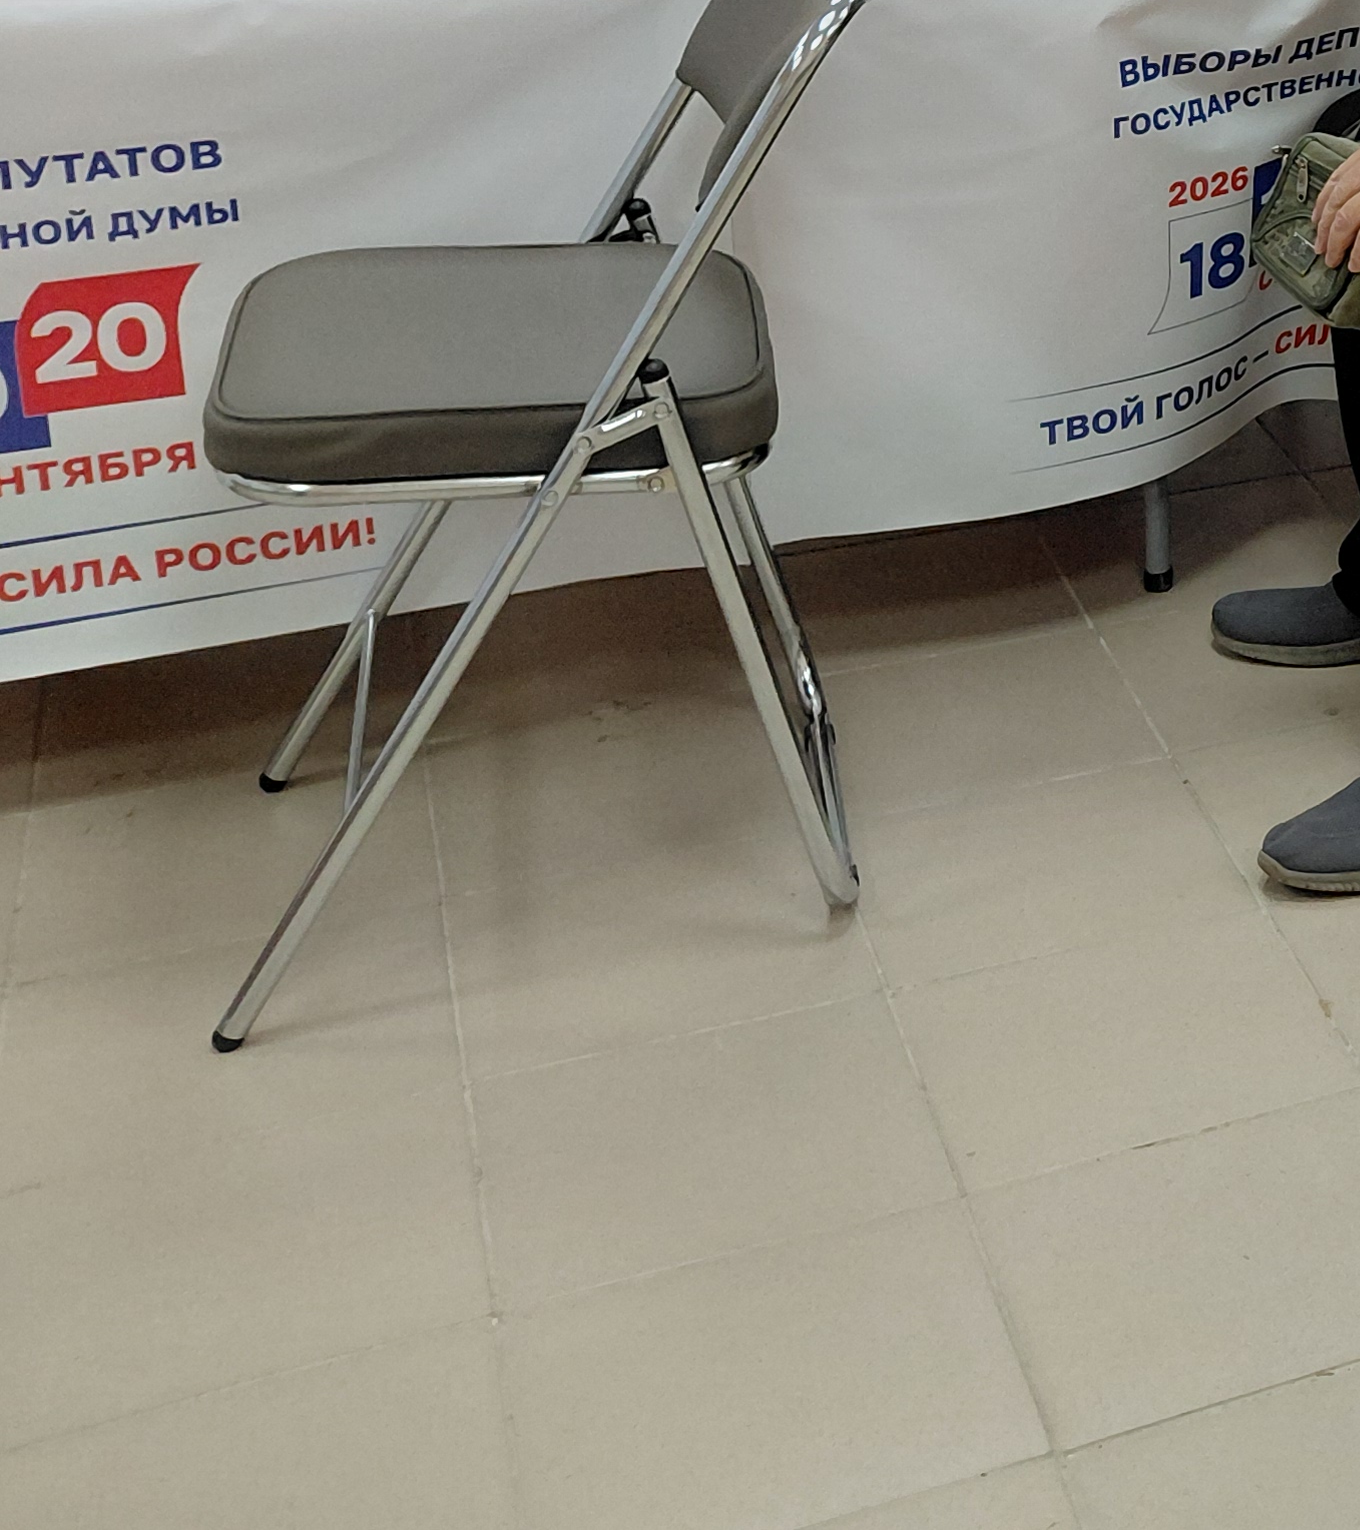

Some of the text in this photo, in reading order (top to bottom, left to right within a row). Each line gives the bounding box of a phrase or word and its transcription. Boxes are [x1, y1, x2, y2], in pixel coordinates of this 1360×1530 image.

[1120, 45, 1283, 88] ВЫБОРЫ
[1169, 166, 1249, 207] 2026
[108, 198, 240, 242] ДУМЫ
[1180, 232, 1247, 300] 18
[30, 301, 167, 385] 20
[1040, 324, 1332, 446] ТВОЙ ГОЛОС СИЛ
[0, 441, 197, 498] НТЯБРЯ
[0, 517, 376, 602] СИЛА РОССИИ!
